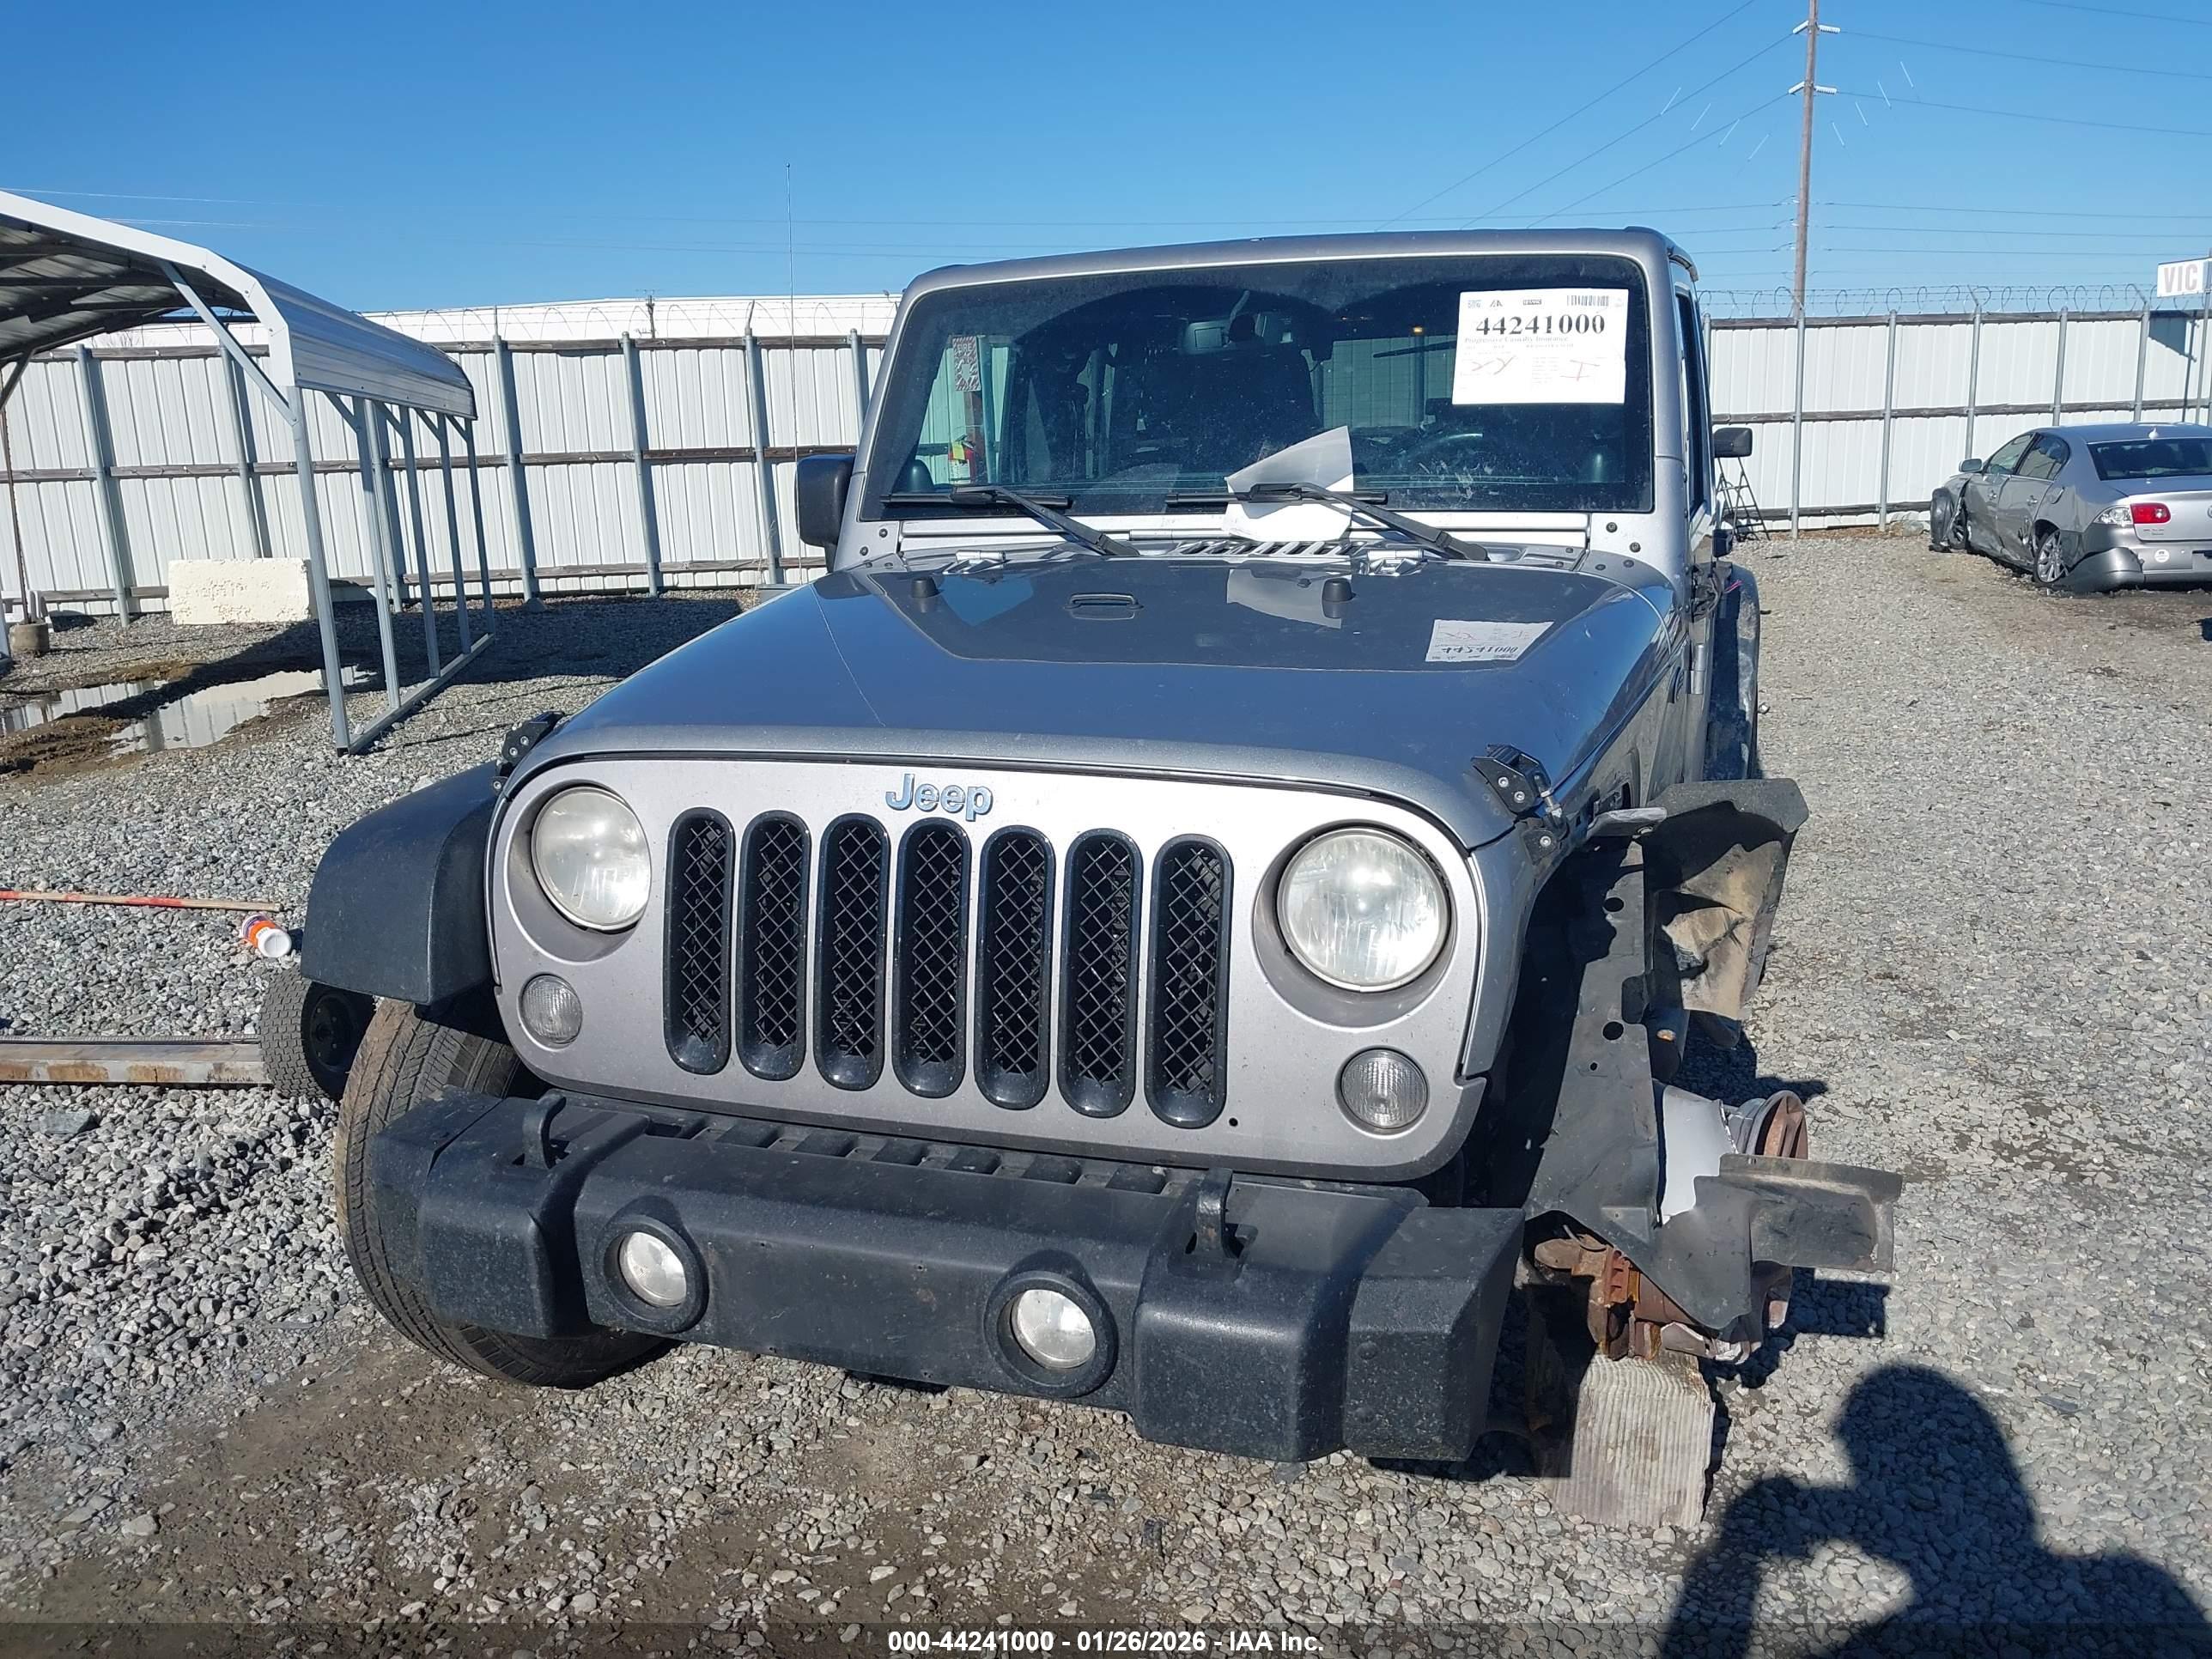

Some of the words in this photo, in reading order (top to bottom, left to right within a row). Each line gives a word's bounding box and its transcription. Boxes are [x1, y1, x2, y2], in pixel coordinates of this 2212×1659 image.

[2164, 264, 2198, 293] VIC
[1476, 314, 1605, 335] 44241000
[885, 773, 994, 822] Jeep
